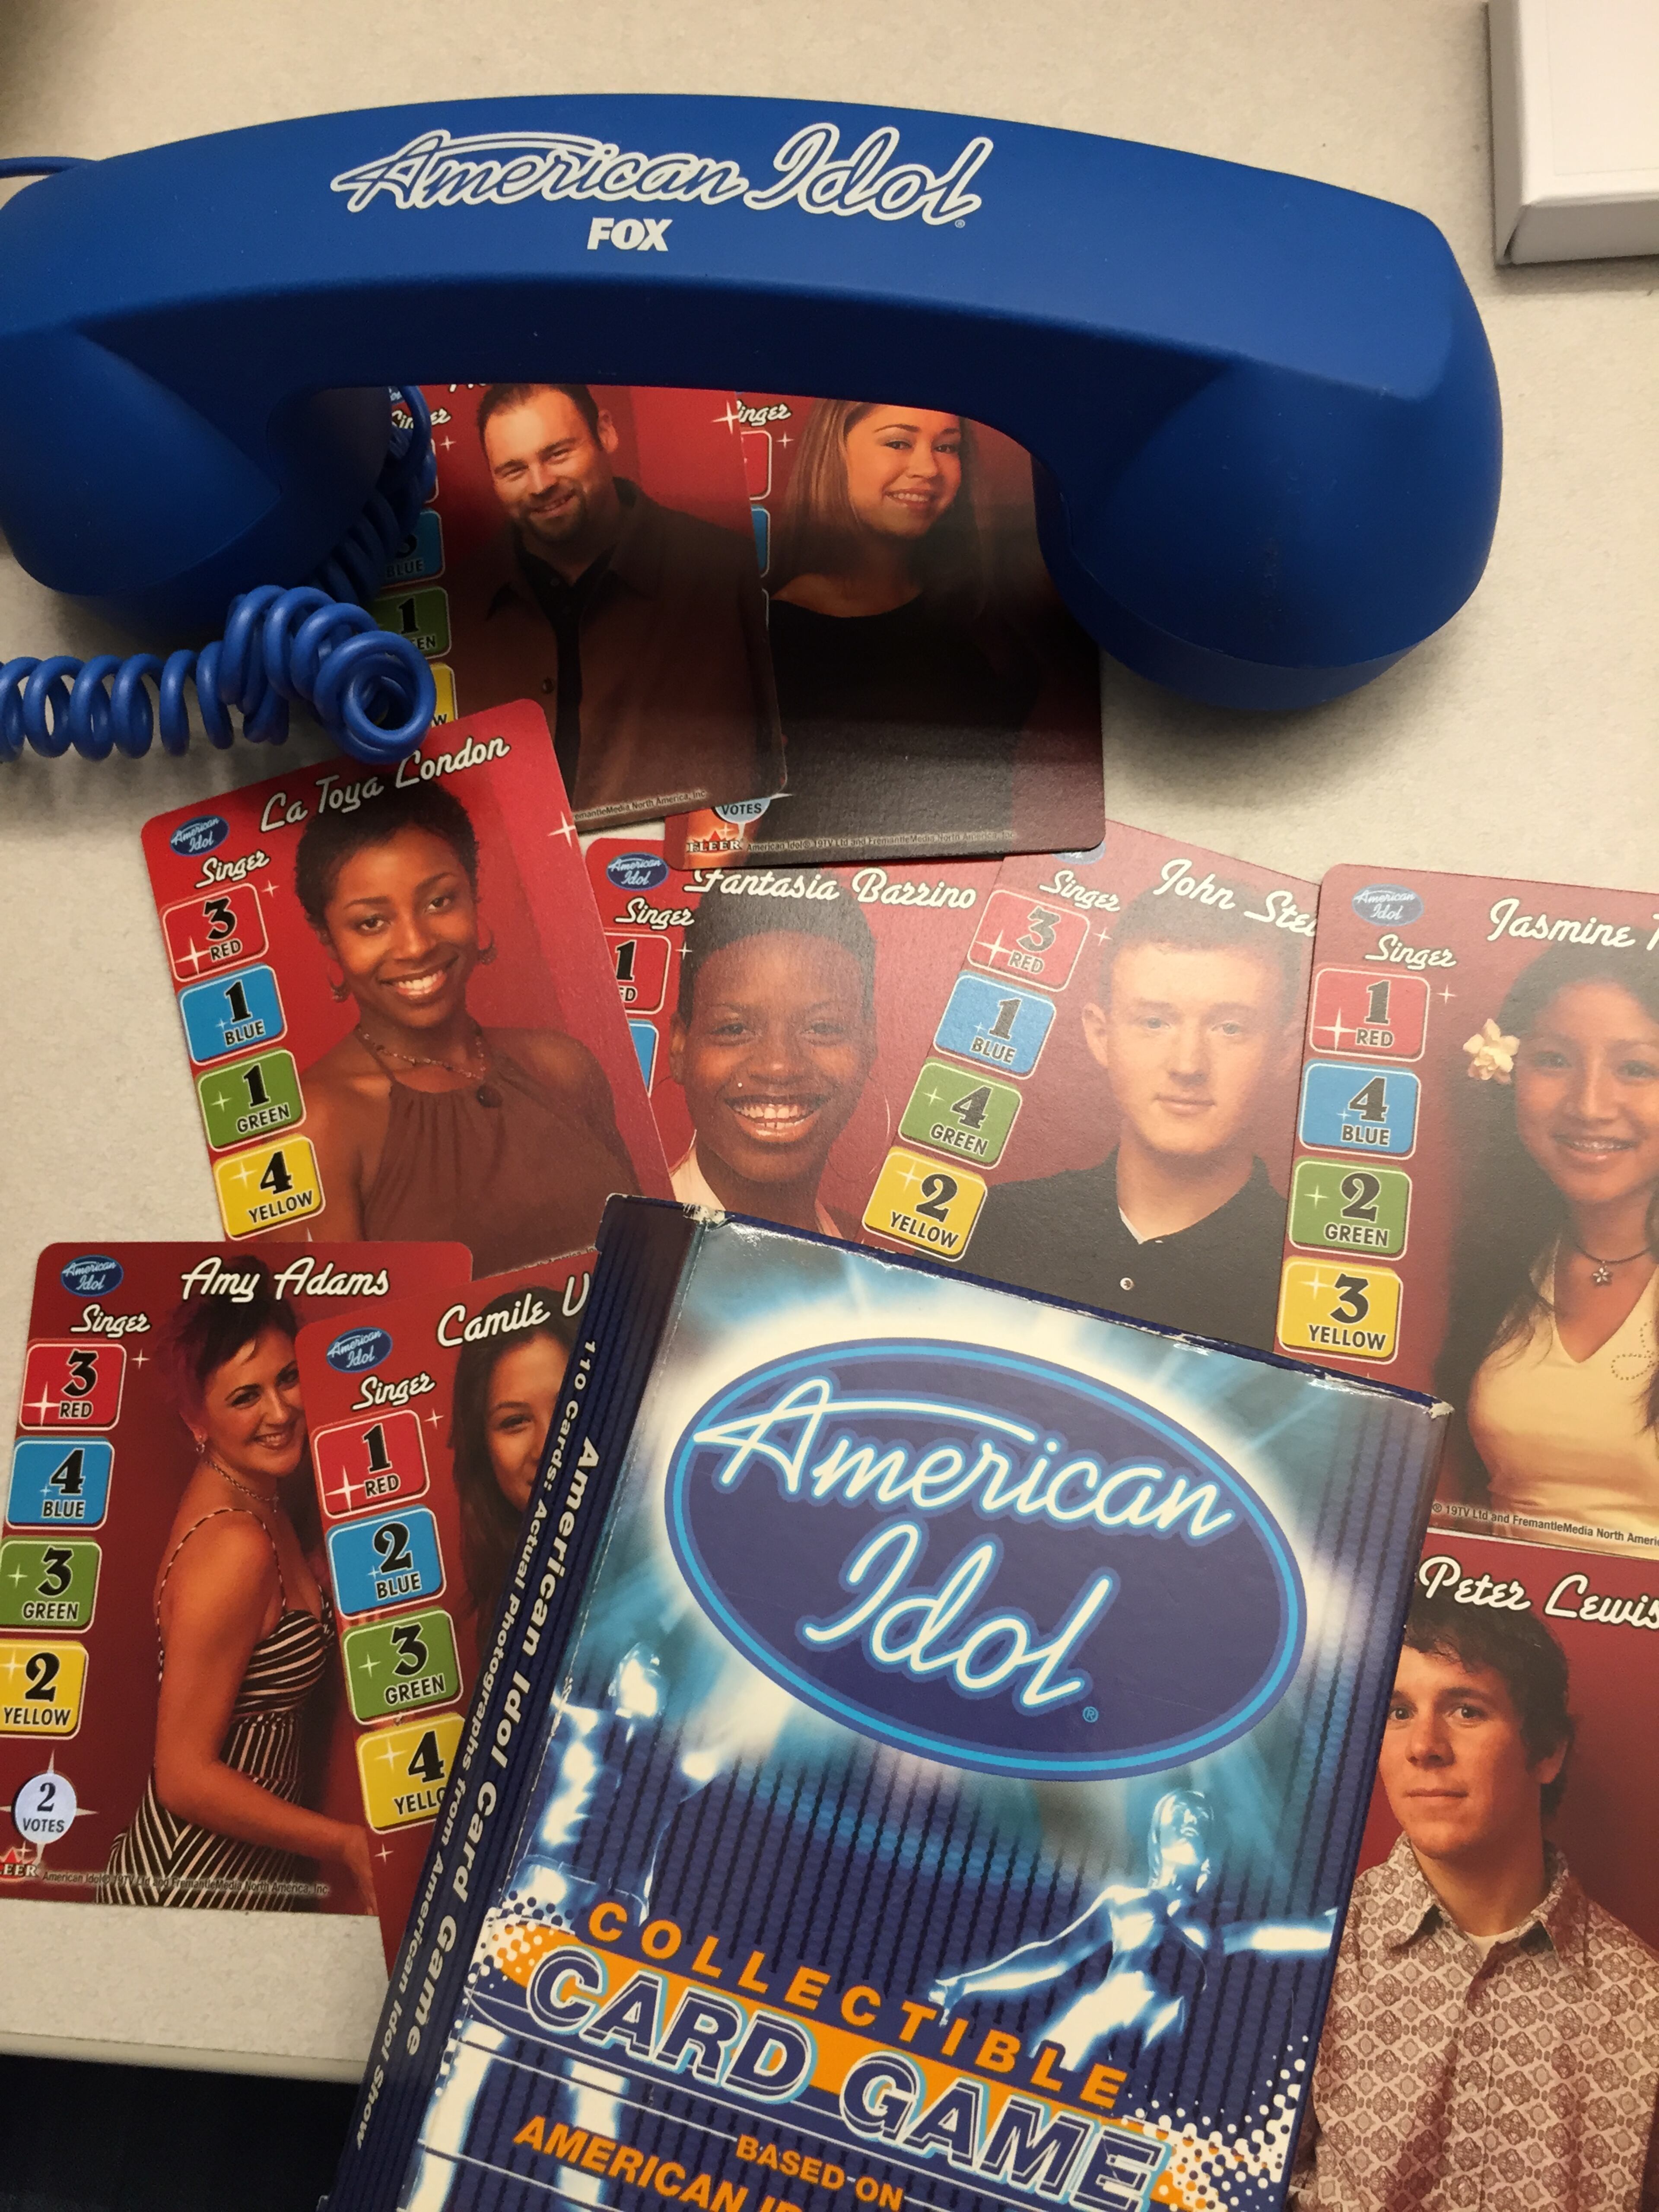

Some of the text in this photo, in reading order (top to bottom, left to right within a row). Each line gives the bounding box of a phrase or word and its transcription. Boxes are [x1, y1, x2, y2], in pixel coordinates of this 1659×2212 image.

[330, 122, 993, 226] American Idol
[588, 218, 668, 251] FOX
[386, 559, 423, 578] BLUE
[398, 598, 419, 634] 1
[261, 737, 510, 832] La Toya London
[574, 805, 630, 820] emantleMedia
[632, 799, 654, 810] North
[721, 803, 762, 815] VOTES
[171, 818, 219, 845] American
[189, 835, 213, 853] Idol
[687, 840, 742, 853] FLEER
[747, 843, 785, 852] American
[195, 850, 269, 888] Singer
[608, 858, 663, 874] American
[624, 869, 651, 887] Idol
[1153, 858, 1236, 909] John
[684, 868, 976, 909] Fantasia Barrino
[1039, 870, 1120, 911] Singer
[1354, 889, 1415, 905] American
[203, 896, 237, 941] 3
[615, 898, 694, 930] Singer
[1017, 906, 1061, 953] 3
[1372, 903, 1402, 921] Idol
[1487, 898, 1636, 947] Jasmine
[210, 939, 241, 962] RED
[616, 941, 636, 981] 1
[1008, 950, 1044, 975] RED
[1365, 934, 1457, 970] Singer
[226, 979, 251, 1024] 1
[989, 998, 1021, 1041] 1
[1366, 979, 1392, 1026] 1
[225, 1021, 265, 1046] BLUE
[971, 1037, 1016, 1064] BLUE
[1356, 1028, 1394, 1048] RED
[242, 1064, 270, 1108] 1
[1348, 1076, 1389, 1123] 4
[236, 1104, 290, 1133] GREEN
[952, 1086, 992, 1128] 4
[930, 1124, 988, 1156] GREEN
[1341, 1125, 1390, 1147] BLUE
[260, 1150, 292, 1195] 4
[248, 1190, 313, 1224] YELLOW
[915, 1173, 959, 1223] 2
[1340, 1172, 1381, 1223] 2
[890, 1211, 959, 1249] YELLOW
[1325, 1223, 1389, 1247] GREEN
[62, 1259, 116, 1277] American
[77, 1274, 106, 1292] Idol
[181, 1256, 390, 1303] Amy Adams
[1329, 1273, 1370, 1324] 3
[70, 1304, 150, 1338] Singer
[437, 1294, 551, 1348] Camile
[1308, 1324, 1386, 1351] YELLOW
[327, 1329, 381, 1358] American
[346, 1346, 375, 1368] Idol
[61, 1349, 98, 1398] 3
[575, 1341, 596, 1390] 110
[59, 1400, 94, 1419] RED
[352, 1372, 435, 1410] Singer
[362, 1423, 392, 1474] 1
[690, 1375, 1236, 1541] American
[51, 1448, 86, 1497] 4
[364, 1473, 401, 1499] RED
[42, 1500, 86, 1519] BLUE
[1446, 1505, 1470, 1517] 19TV
[1472, 1510, 1488, 1520] Ltd
[1491, 1513, 1510, 1523] and
[1512, 1515, 1593, 1536] FremantleMedia
[1596, 1528, 1624, 1541] North
[372, 1522, 413, 1574] 2
[514, 1498, 547, 1589] Actual
[36, 1546, 74, 1597] 3
[375, 1572, 422, 1601] BLUE
[22, 1601, 79, 1622] GREEN
[1418, 1556, 1659, 1630] Peter Lewis
[803, 1520, 1115, 1709] Idol
[391, 1621, 429, 1676] 3
[25, 1653, 61, 1703] 2
[384, 1673, 445, 1706] GREEN
[462, 1596, 522, 1771] Photographs
[3, 1706, 72, 1728] YELLOW
[407, 1436, 600, 2056] American Idol Card Game
[407, 1730, 445, 1783] 4
[36, 1783, 56, 1812] 2
[394, 1789, 446, 1815] YELLO
[440, 1777, 466, 1847] from
[22, 1818, 66, 1835] VOTES
[0, 1864, 38, 1878] EER
[43, 1872, 83, 1883] American
[173, 1878, 242, 1891] FremantleMedia
[245, 1881, 269, 1891] North
[399, 1858, 444, 1995] American
[587, 1900, 1128, 2110] COLLECTIBLE
[382, 1997, 403, 2062] Idol
[527, 1946, 1169, 2212] CARD GAME
[357, 2065, 385, 2151] Show
[513, 2115, 748, 2212] AMERICAN
[736, 2134, 905, 2212] BASED ON
